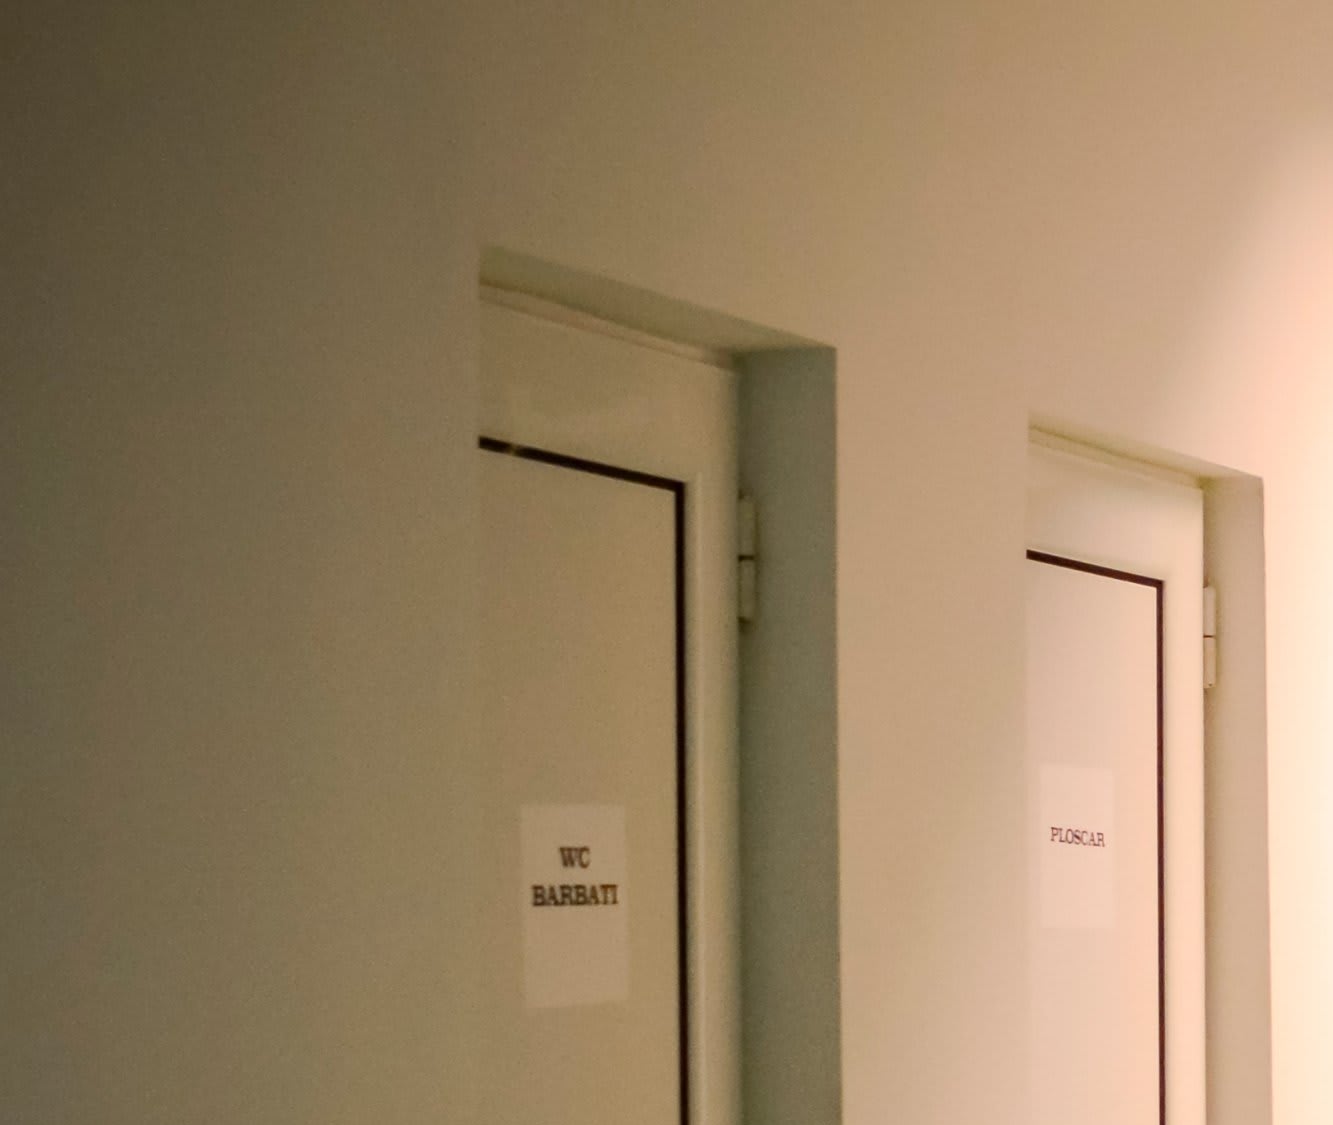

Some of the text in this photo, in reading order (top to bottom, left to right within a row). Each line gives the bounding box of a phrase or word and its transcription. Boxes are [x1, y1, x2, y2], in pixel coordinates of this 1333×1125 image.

[1050, 826, 1105, 847] PLOSCAR
[559, 846, 591, 868] WC
[532, 884, 618, 906] BARBATI
